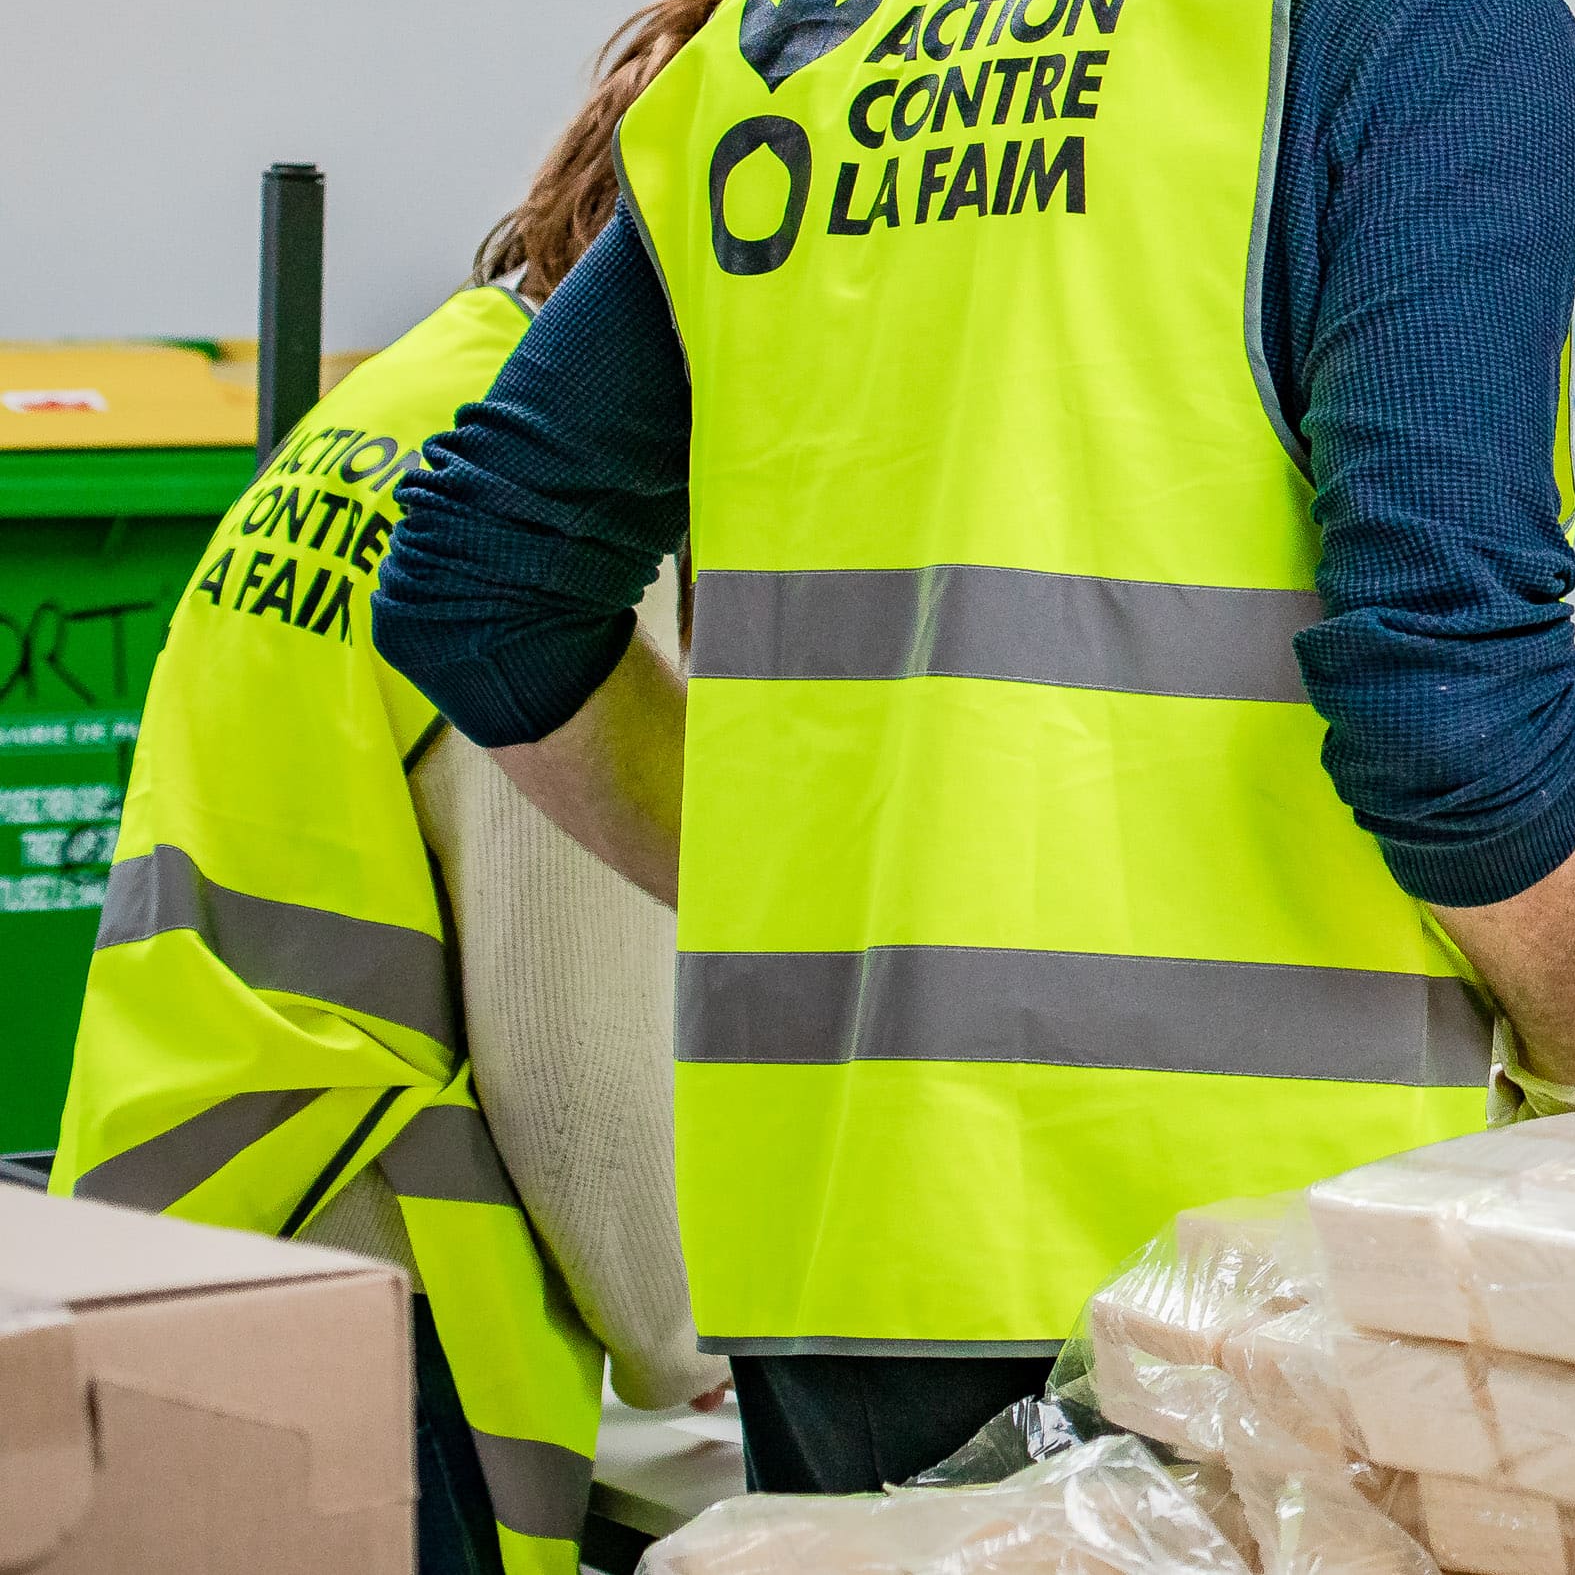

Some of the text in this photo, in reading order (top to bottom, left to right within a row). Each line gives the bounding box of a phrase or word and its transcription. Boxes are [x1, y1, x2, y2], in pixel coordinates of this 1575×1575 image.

[848, 50, 1109, 149] CONTRE
[827, 136, 1086, 235] LA FAIM
[233, 485, 394, 575] ONTRE
